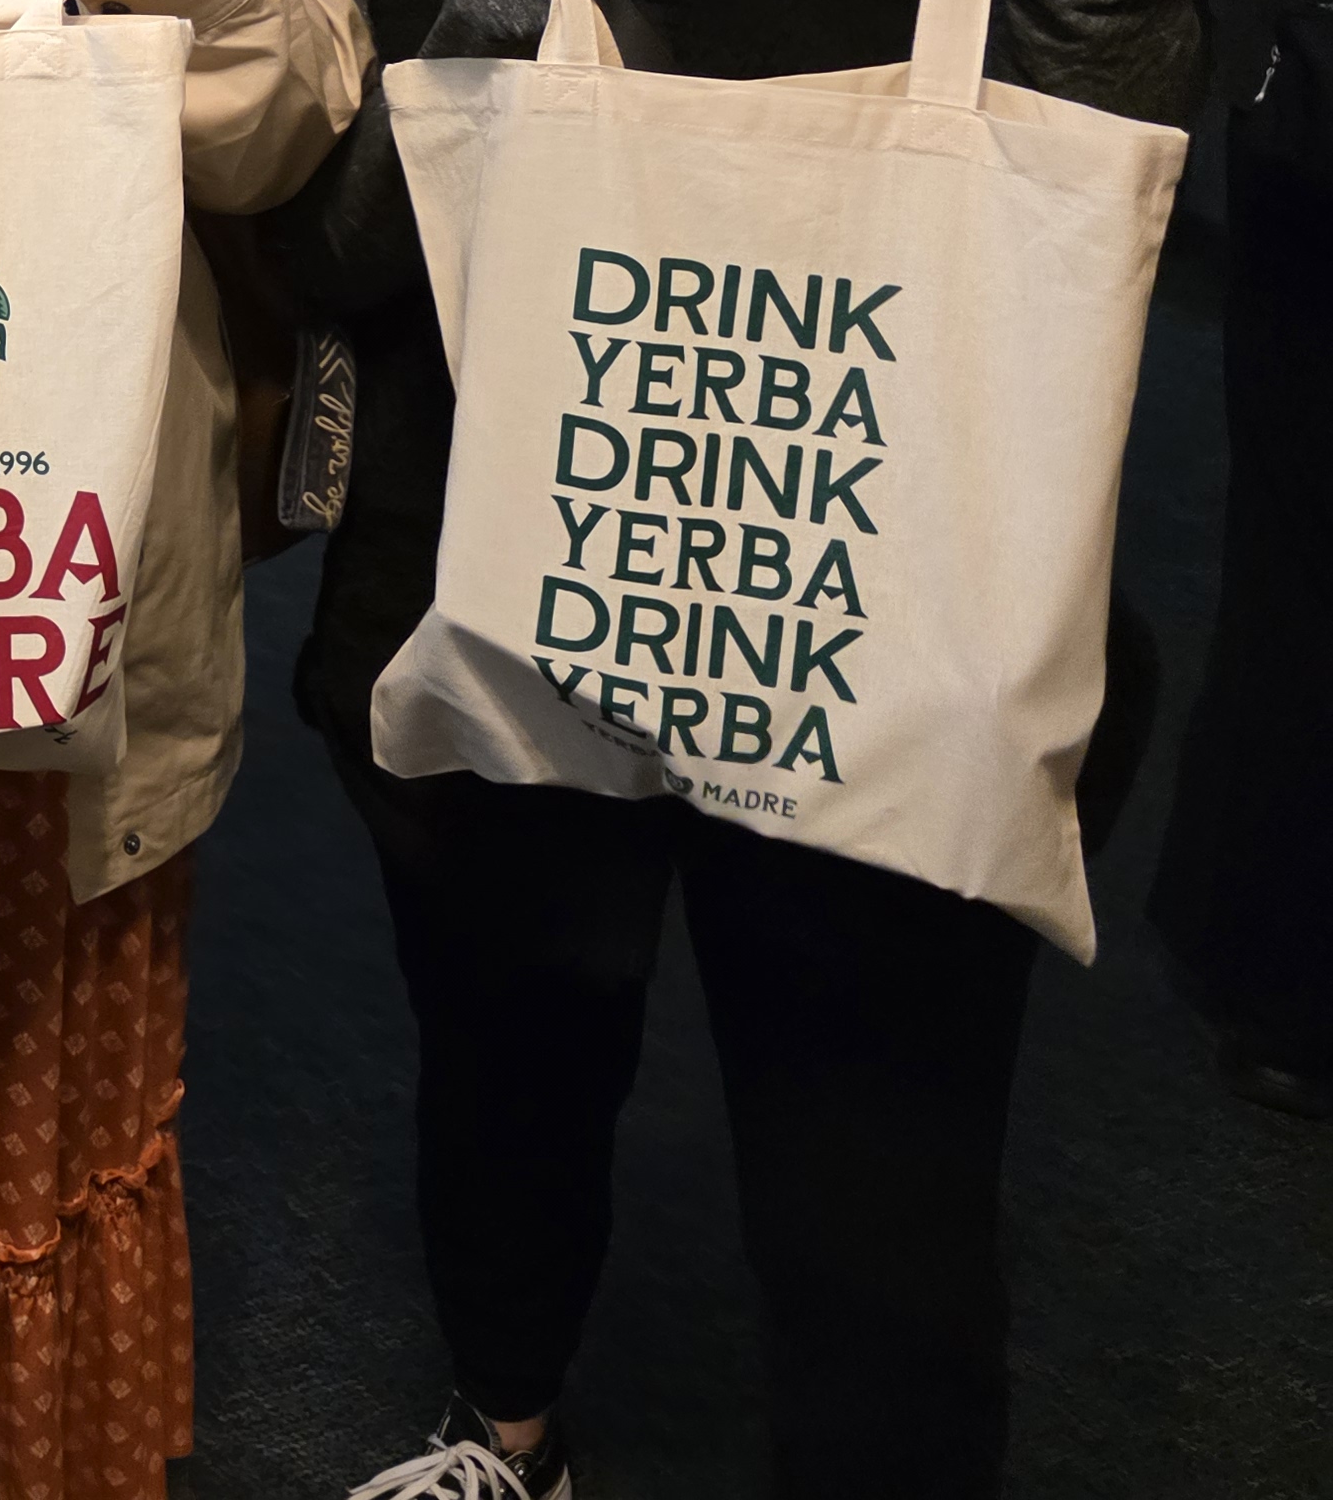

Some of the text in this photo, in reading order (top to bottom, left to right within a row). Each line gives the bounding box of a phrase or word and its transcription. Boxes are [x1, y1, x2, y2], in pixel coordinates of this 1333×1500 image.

[573, 247, 902, 362] DRINK
[568, 331, 887, 447] YERBA
[556, 414, 883, 535] DRINK
[551, 495, 868, 619] YERBA
[535, 575, 864, 704] DRINK
[531, 655, 844, 785] YERBA
[701, 780, 799, 820] MADRE
